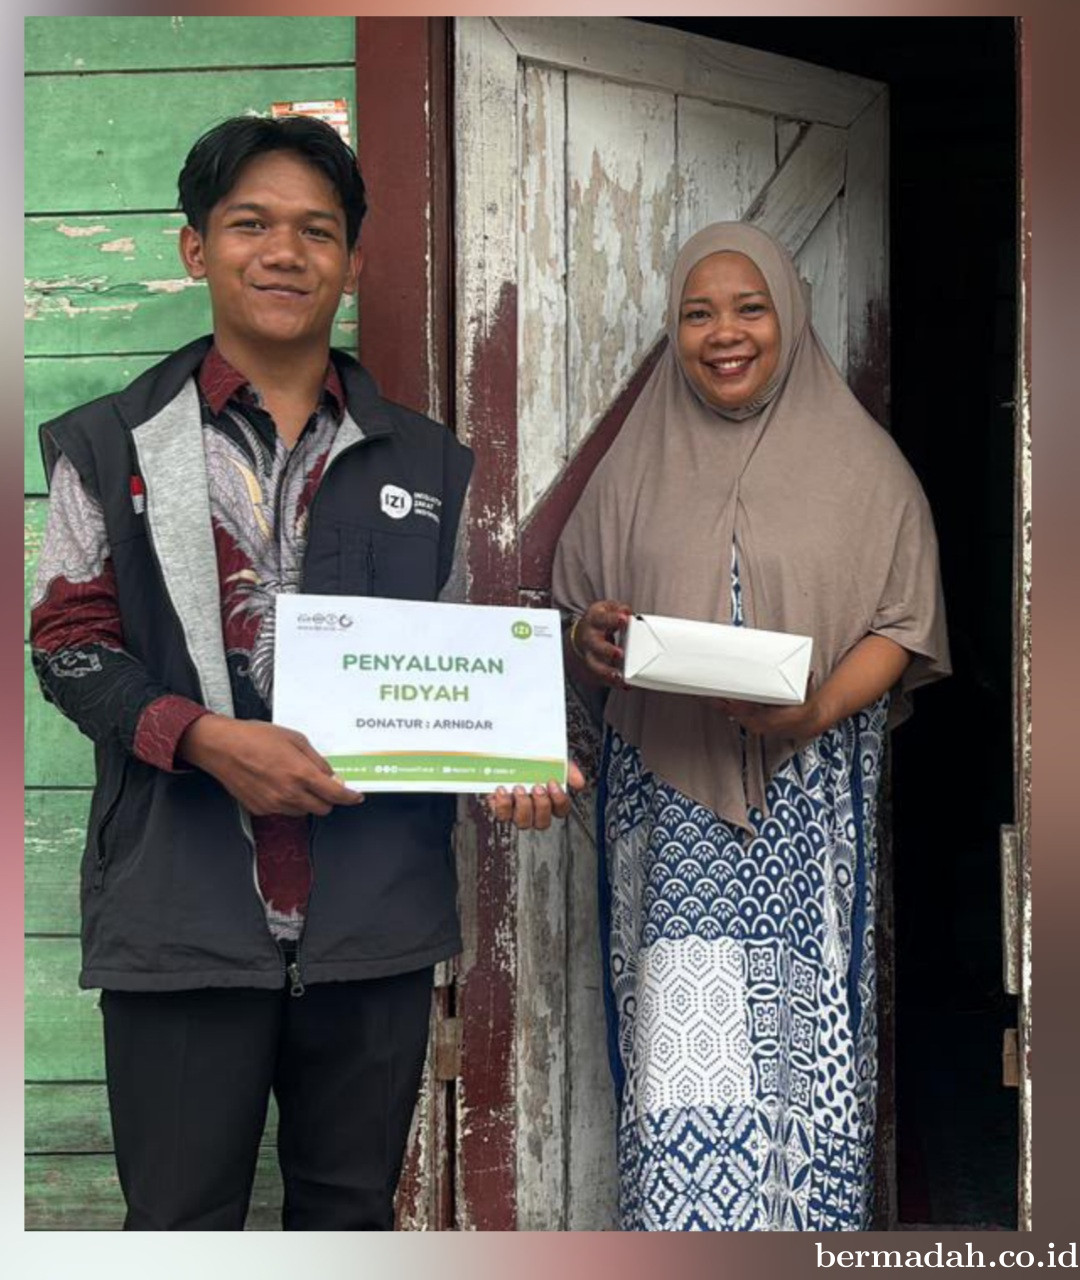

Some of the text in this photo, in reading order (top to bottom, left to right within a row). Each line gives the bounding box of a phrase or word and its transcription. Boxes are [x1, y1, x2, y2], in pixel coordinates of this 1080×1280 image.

[384, 492, 405, 509] IZI
[343, 654, 504, 675] PENYALURAN
[380, 684, 470, 702] FIDYAH
[356, 717, 423, 729] DONATUR
[432, 719, 493, 730] ARNIDAR
